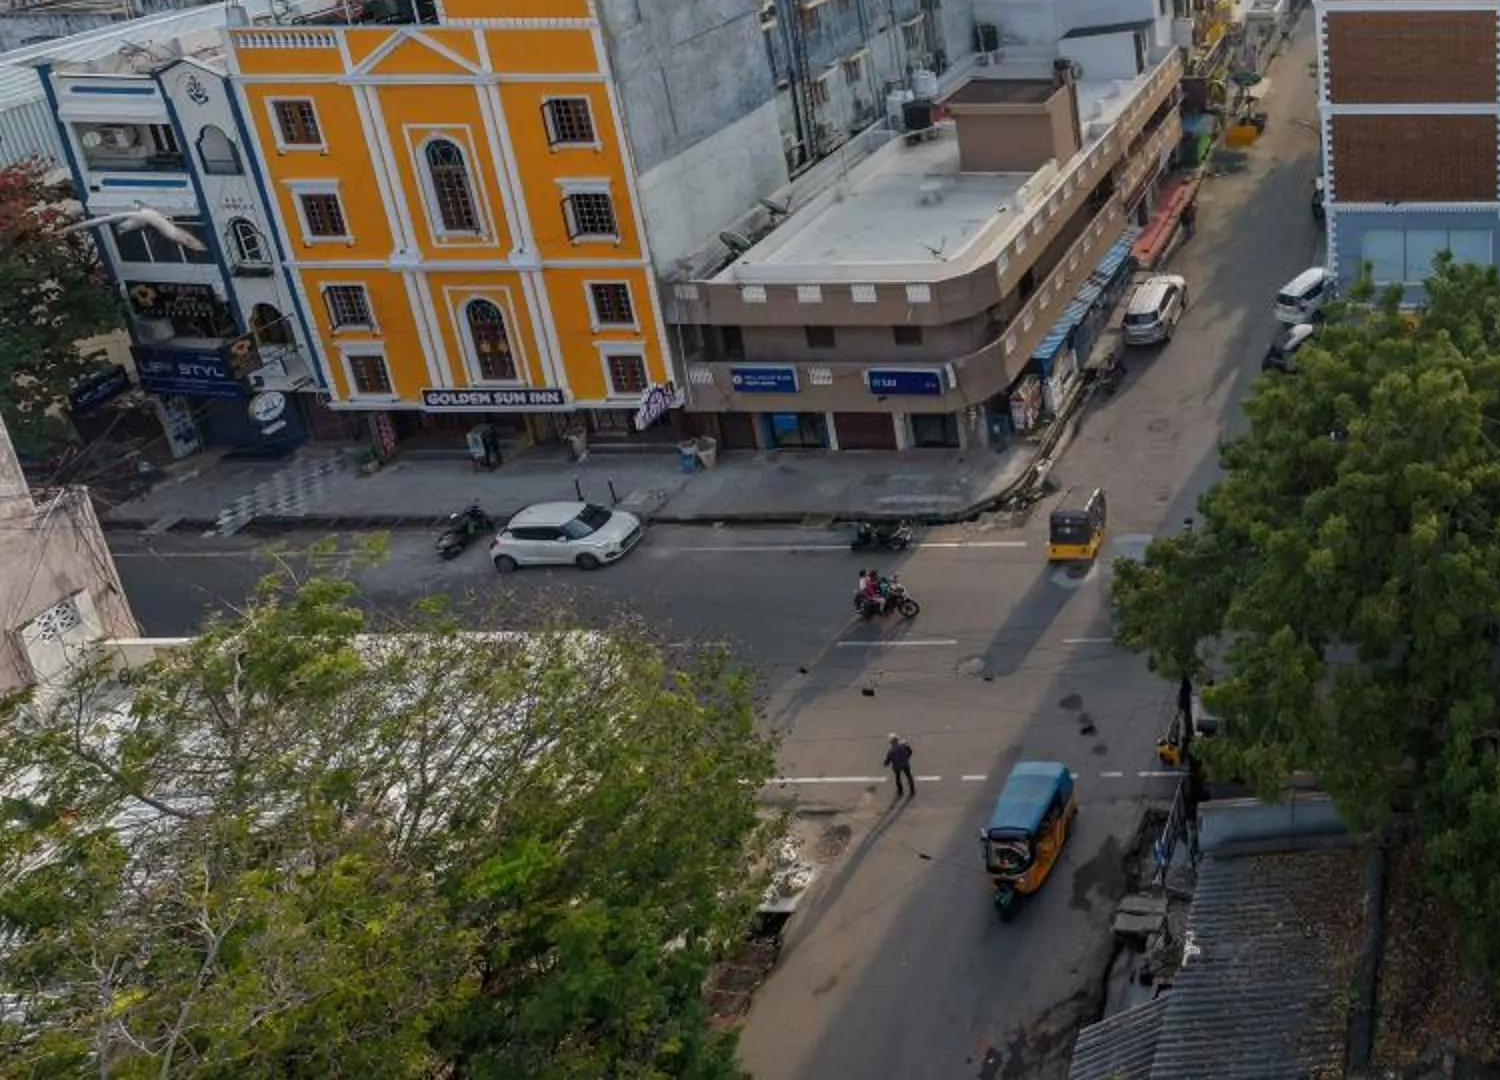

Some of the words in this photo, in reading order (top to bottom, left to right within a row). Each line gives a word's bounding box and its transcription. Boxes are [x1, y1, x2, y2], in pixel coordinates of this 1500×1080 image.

[427, 392, 491, 405] GOLDEN
[494, 391, 527, 405] SUN
[529, 391, 560, 404] INN
